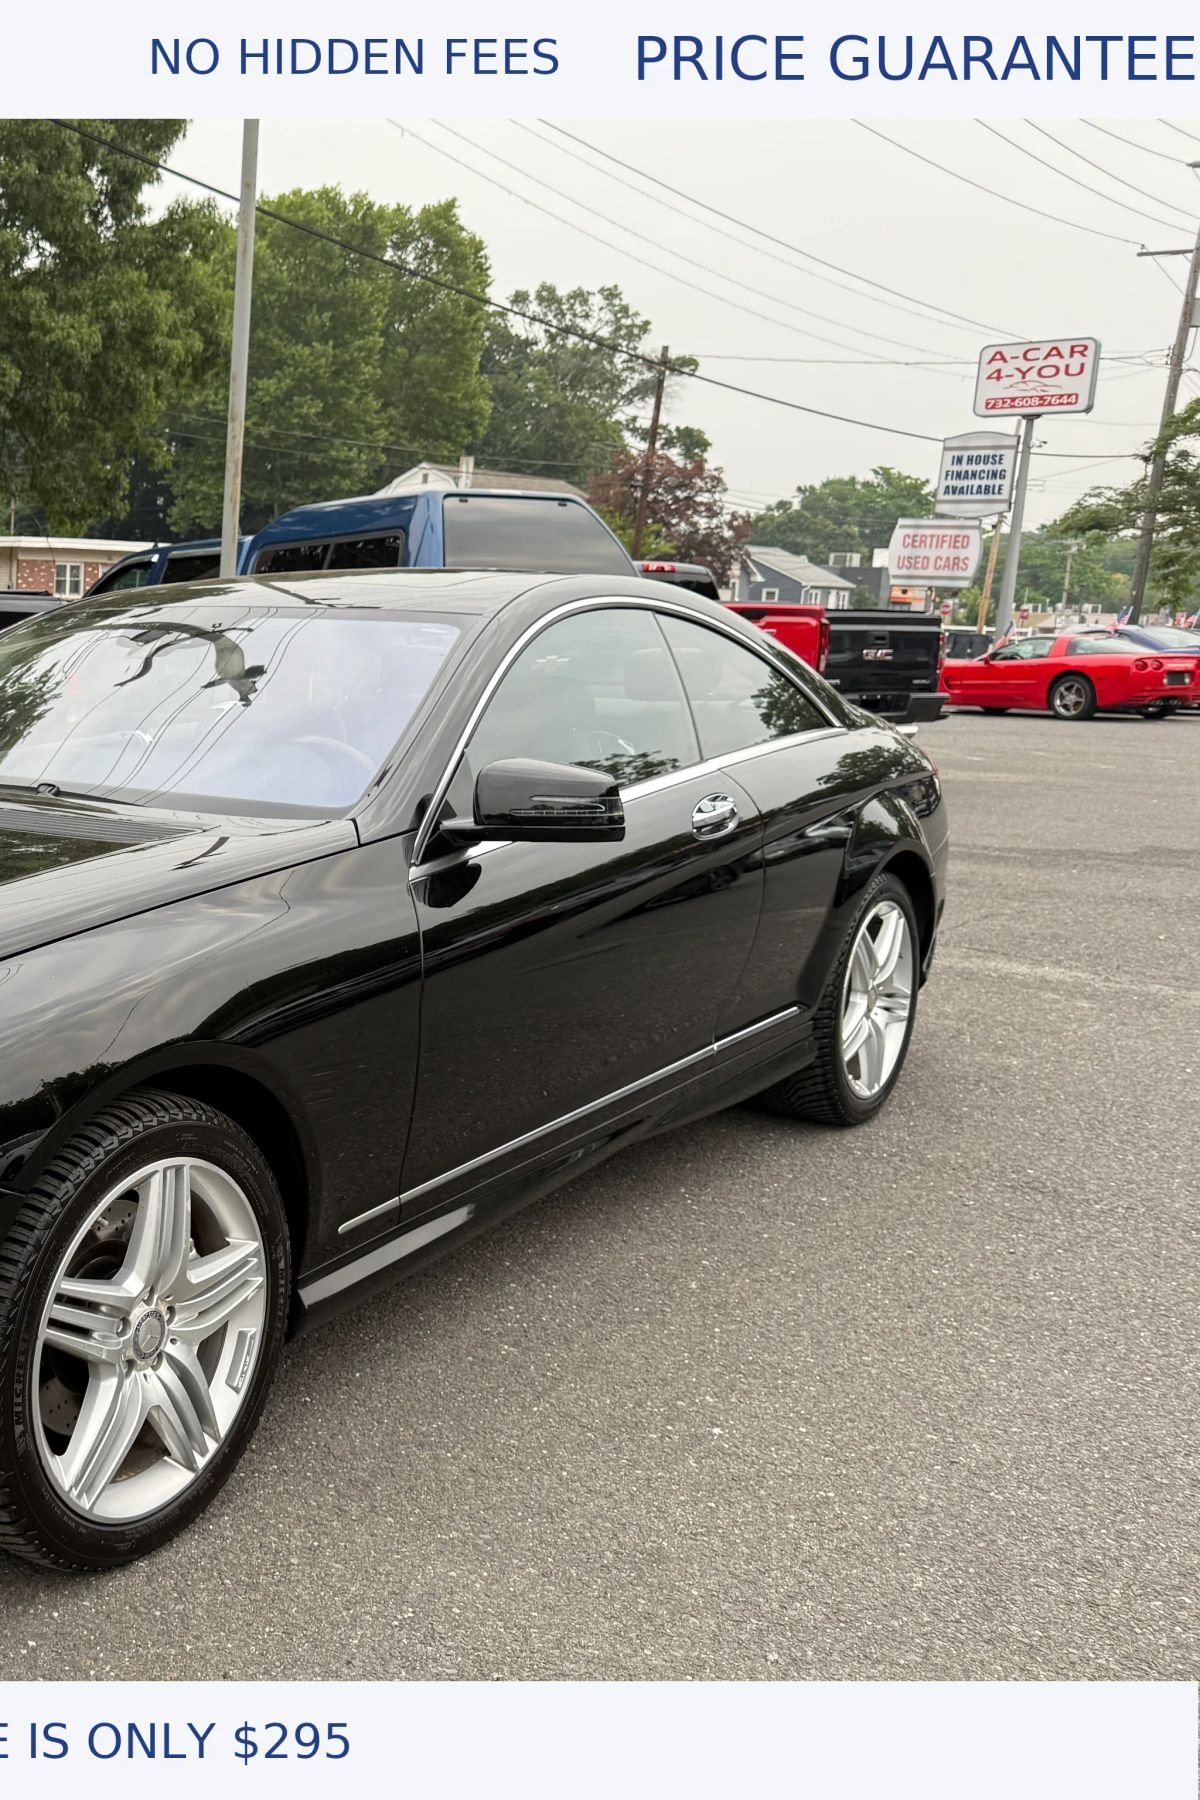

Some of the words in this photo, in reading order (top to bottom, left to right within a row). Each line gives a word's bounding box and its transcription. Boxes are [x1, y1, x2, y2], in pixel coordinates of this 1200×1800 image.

[987, 344, 1088, 364] A-CAR
[986, 363, 1085, 381] 4-YOU
[986, 394, 1077, 409] 732-608-7644
[951, 455, 963, 466] IN
[966, 454, 1004, 466] HOUSE
[944, 469, 1006, 481] FINANCING
[943, 484, 1004, 496] AVAILABLE
[902, 534, 970, 549] CERTIFIED
[897, 556, 930, 570] USED
[933, 556, 970, 571] CARS
